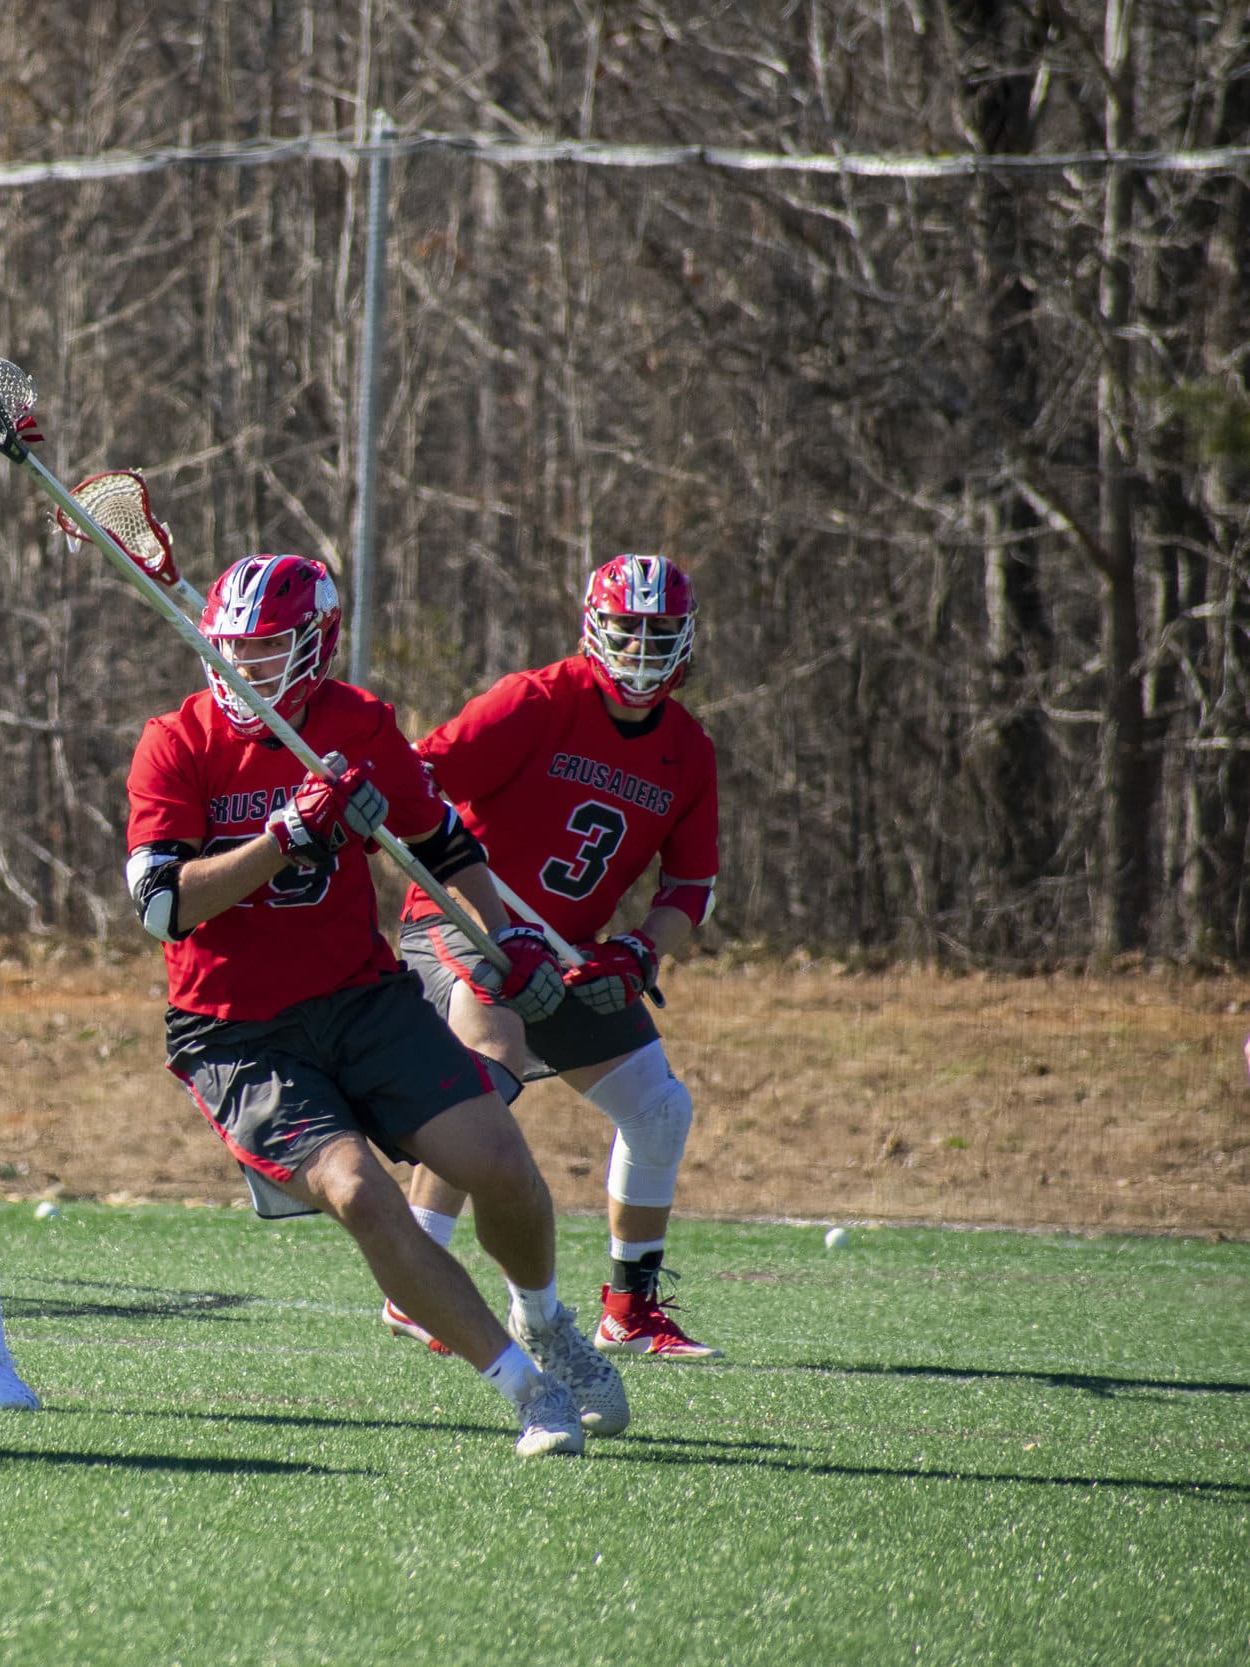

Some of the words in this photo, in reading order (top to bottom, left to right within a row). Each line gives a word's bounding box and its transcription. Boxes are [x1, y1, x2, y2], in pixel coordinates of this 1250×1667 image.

[547, 752, 675, 817] CRUSADERS
[539, 799, 628, 902] 3
[603, 1314, 630, 1344] NIKE
